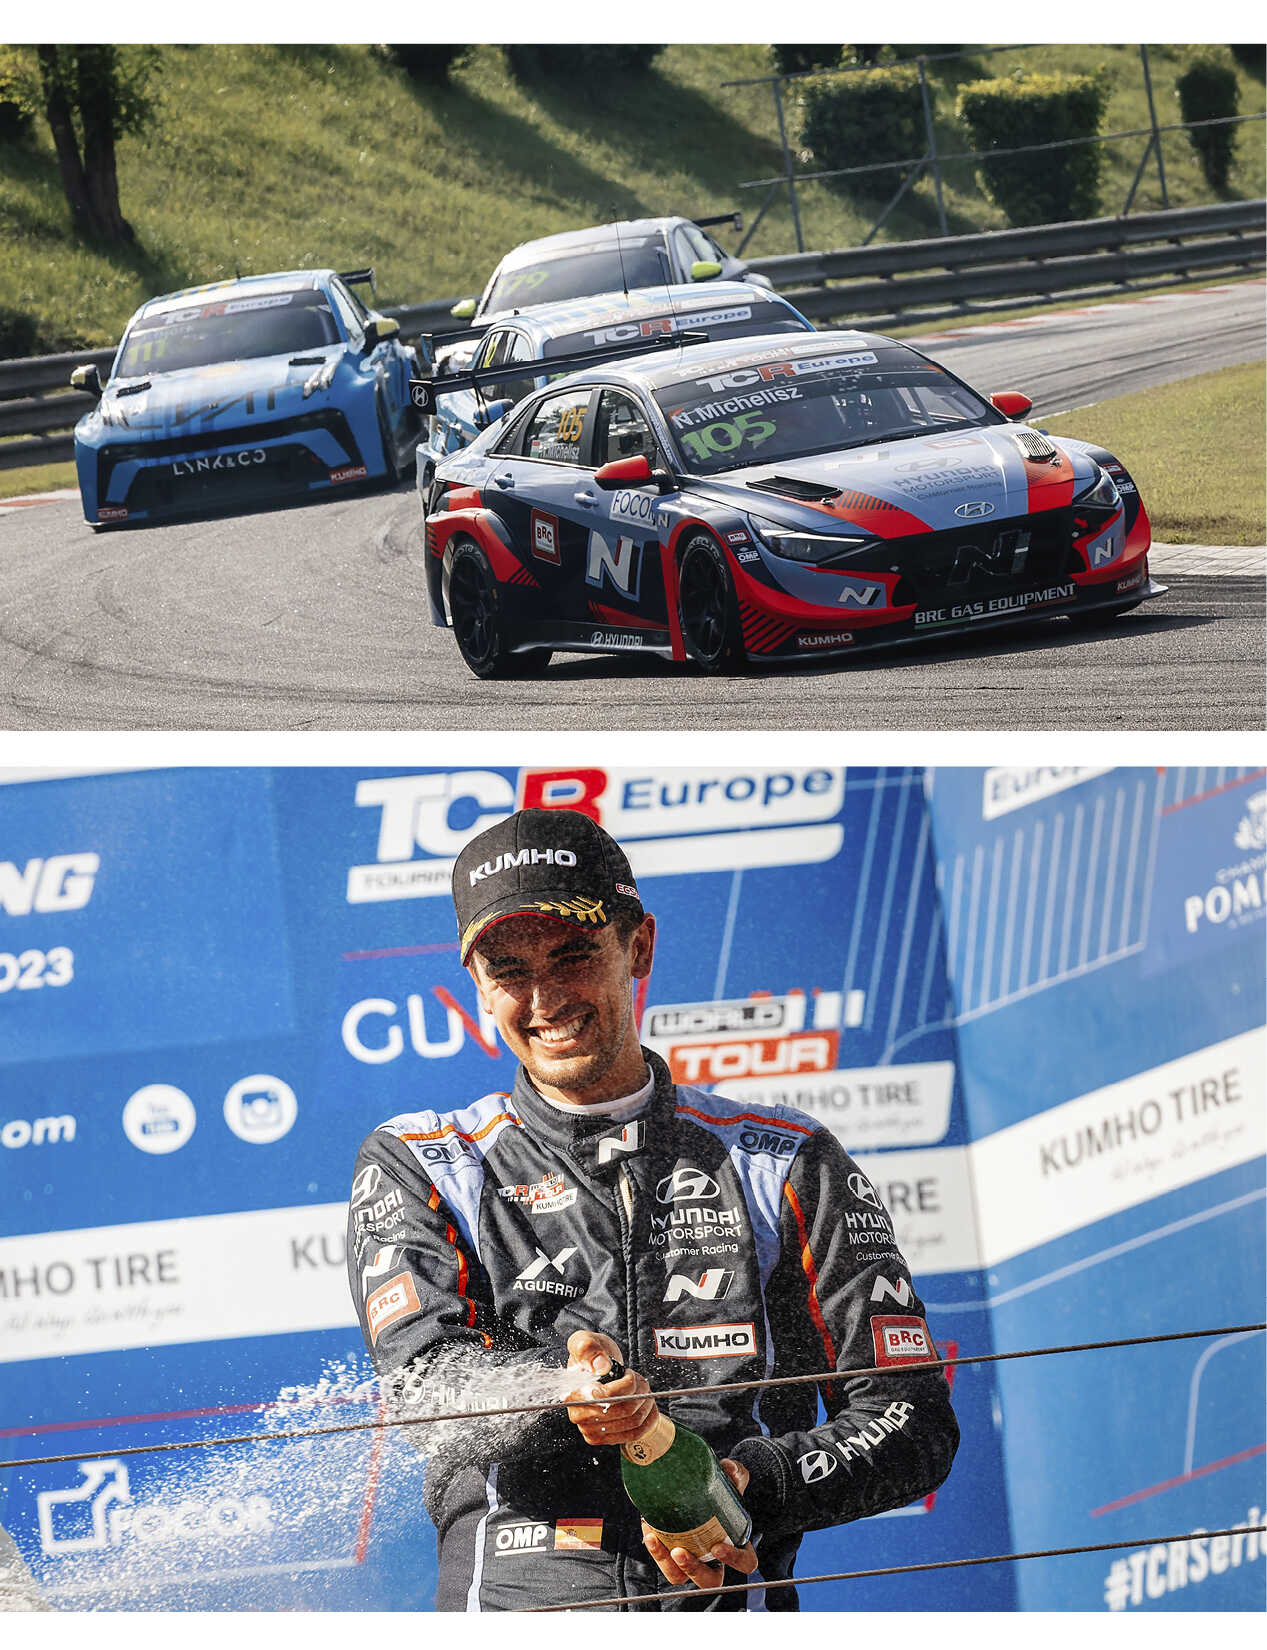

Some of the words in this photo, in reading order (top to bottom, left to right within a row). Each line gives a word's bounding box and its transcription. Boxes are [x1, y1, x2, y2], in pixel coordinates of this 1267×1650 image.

[584, 319, 672, 346] TCR
[675, 308, 749, 327] Europe
[696, 362, 797, 393] TCR
[798, 353, 876, 371] Europe
[557, 407, 588, 442] 105
[679, 410, 777, 461] 105
[537, 526, 552, 543] BRC
[915, 608, 946, 625] BRC
[951, 601, 984, 619] GAS
[988, 583, 1077, 612] EQUIPMENT
[798, 632, 853, 646] KUMHO
[354, 768, 607, 864] TCR
[621, 769, 834, 810] Europe
[468, 849, 577, 888] KUMHO
[1184, 872, 1267, 933] POM
[674, 1037, 831, 1082] TOUR
[859, 1081, 921, 1107] TIRE
[1039, 1098, 1163, 1176] KUMHO
[1169, 1067, 1243, 1122] TIRE
[739, 1131, 796, 1154] OMP
[701, 1243, 739, 1256] Racing
[84, 1249, 180, 1291] TIRE
[660, 1331, 750, 1350] KUMHO
[888, 1330, 924, 1347] BRC
[496, 1524, 548, 1551] OMP
[1104, 1506, 1267, 1612] #TCRSeri
